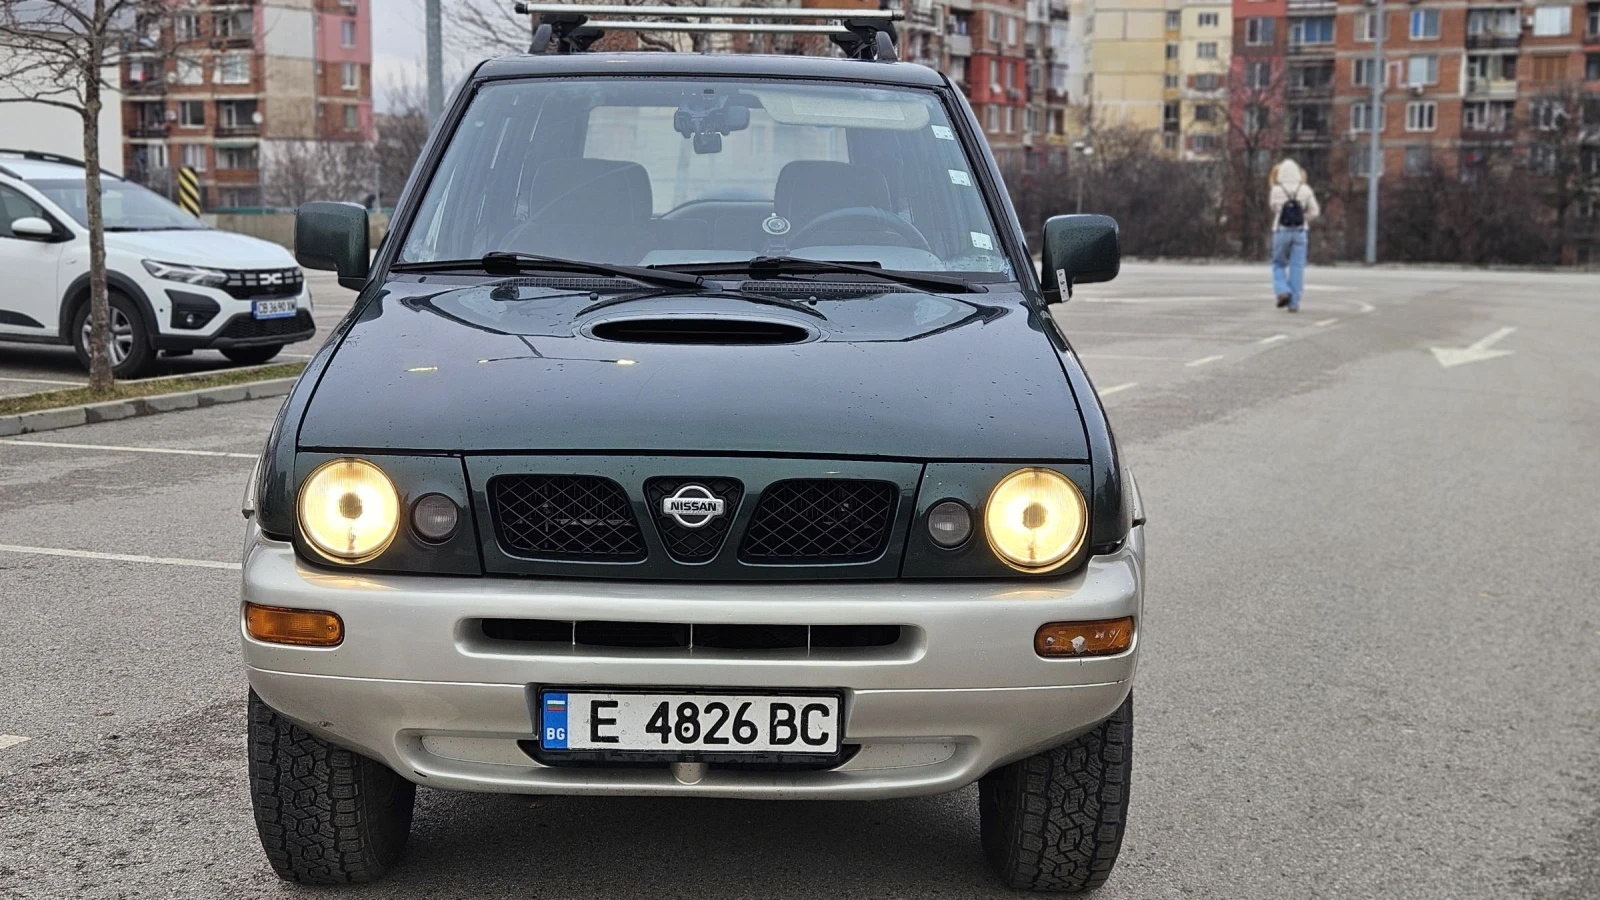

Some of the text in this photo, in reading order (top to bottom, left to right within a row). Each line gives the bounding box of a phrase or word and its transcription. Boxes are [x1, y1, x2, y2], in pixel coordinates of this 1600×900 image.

[258, 302, 268, 314] CB
[670, 501, 717, 512] NISSAN
[590, 699, 830, 746] E 4826 BC
[546, 727, 566, 740] BG
